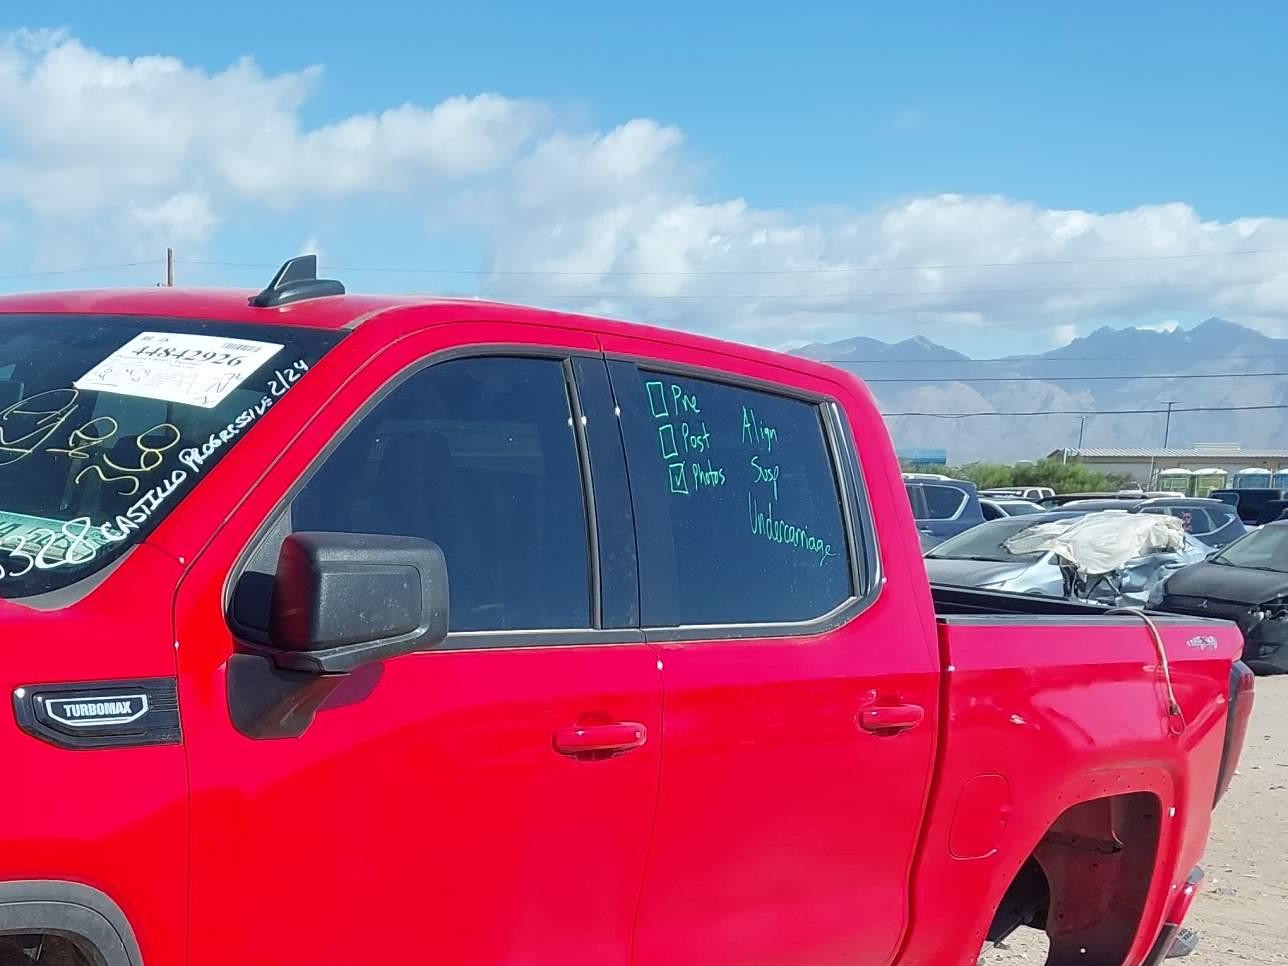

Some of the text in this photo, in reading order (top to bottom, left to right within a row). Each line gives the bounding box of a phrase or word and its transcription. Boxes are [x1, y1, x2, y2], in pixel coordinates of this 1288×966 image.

[131, 344, 243, 367] 44842926
[671, 384, 701, 416] Pre
[681, 422, 712, 453] Post
[741, 405, 778, 452] Align
[75, 423, 181, 496] 360
[100, 470, 188, 541] CASTILLO
[178, 396, 273, 473] PROGRESSIVE
[267, 358, 310, 397] 2/24
[691, 458, 727, 491] Photos
[750, 455, 780, 501] Susp
[748, 491, 838, 566] Undercarriage
[62, 701, 133, 718] TURBOMAX
